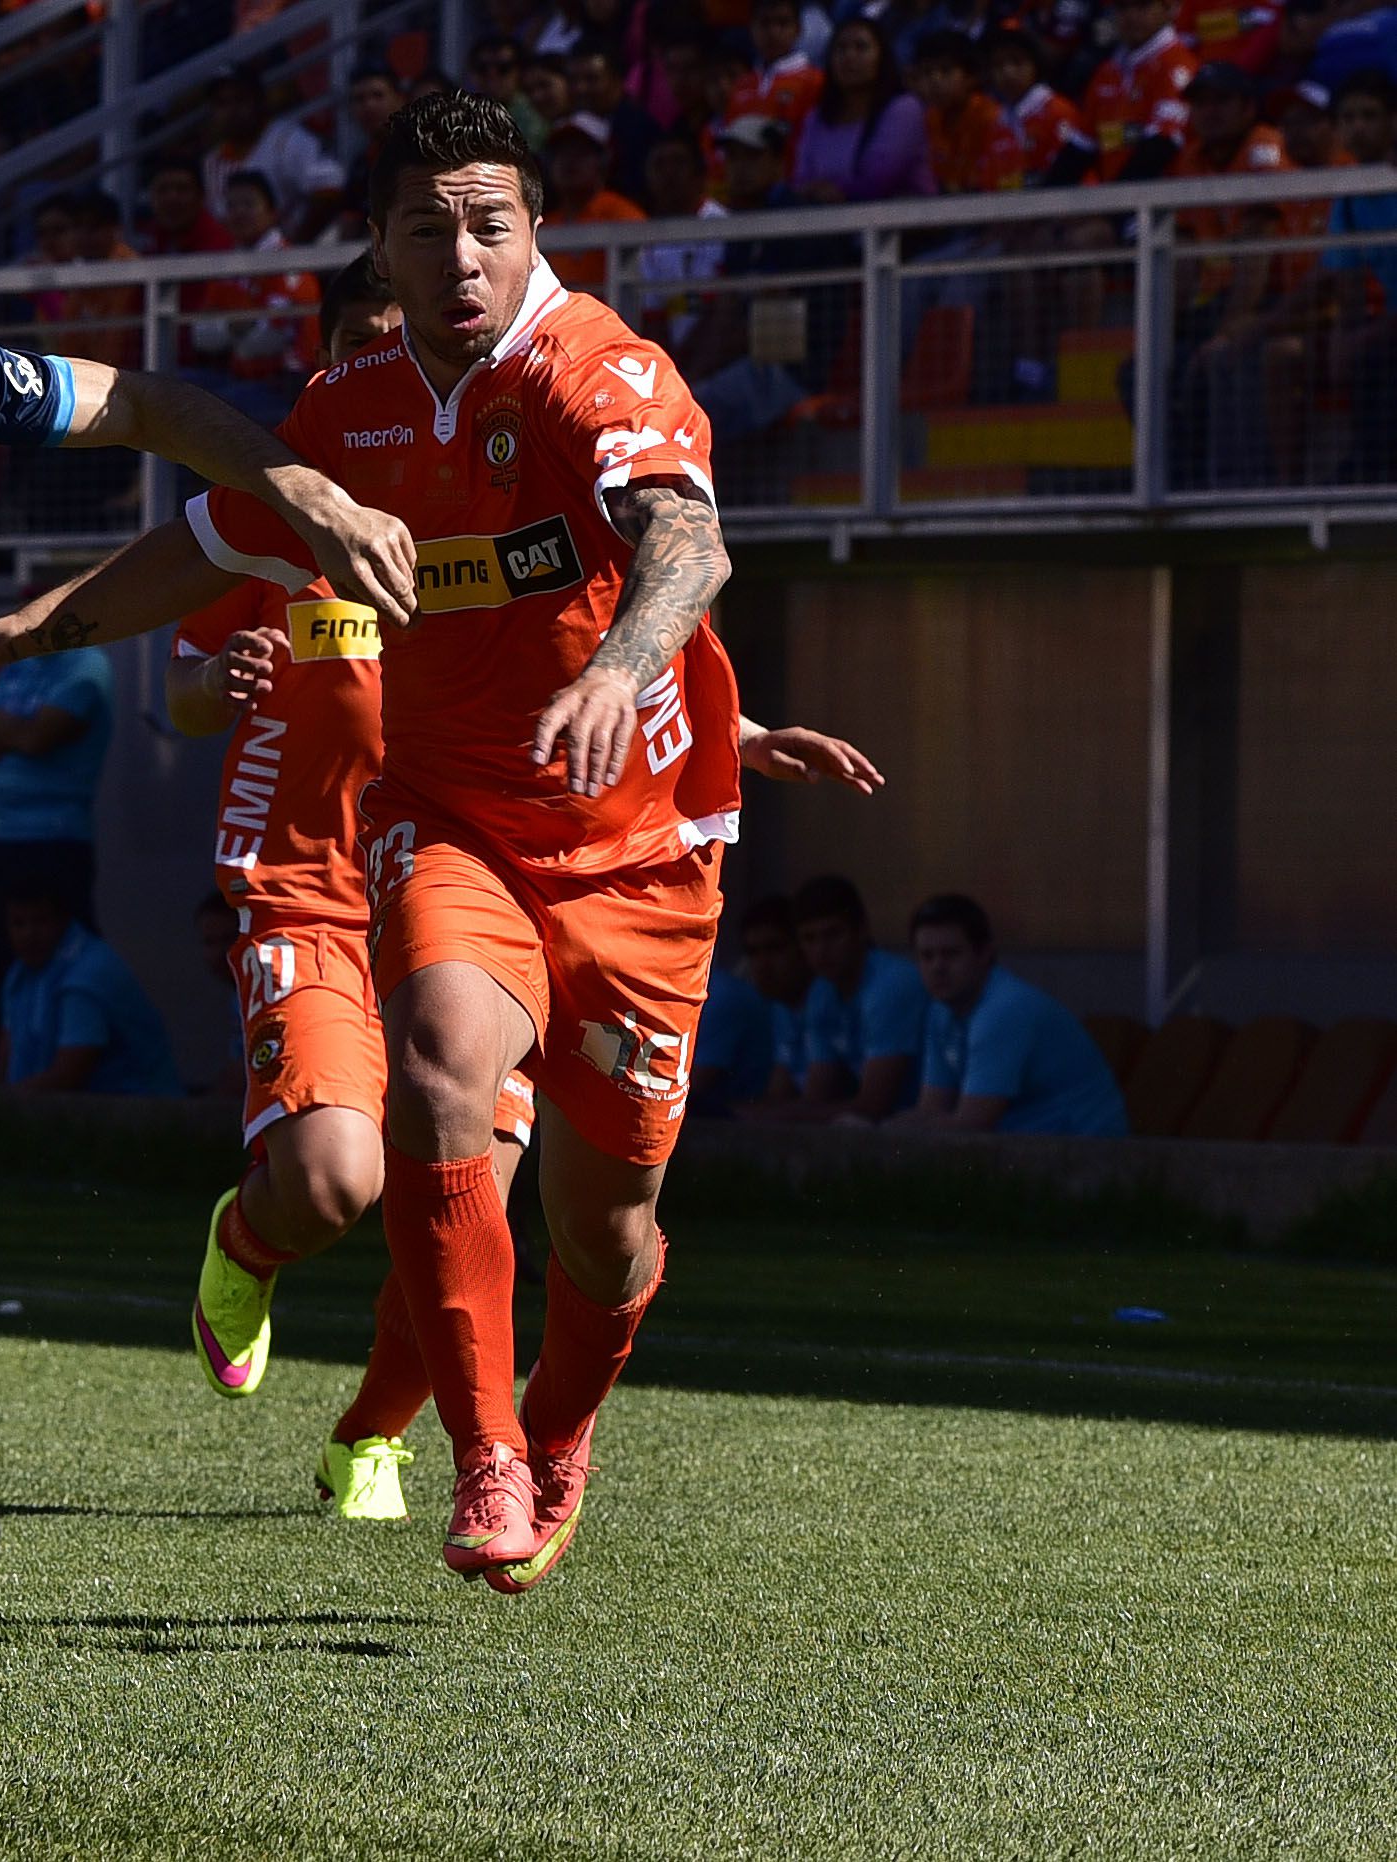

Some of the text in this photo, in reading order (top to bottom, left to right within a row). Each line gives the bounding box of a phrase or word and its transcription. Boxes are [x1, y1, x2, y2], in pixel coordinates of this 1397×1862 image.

[354, 344, 404, 369] entel
[343, 424, 414, 449] macron
[507, 537, 562, 580] CAT
[242, 936, 295, 1020] 20
